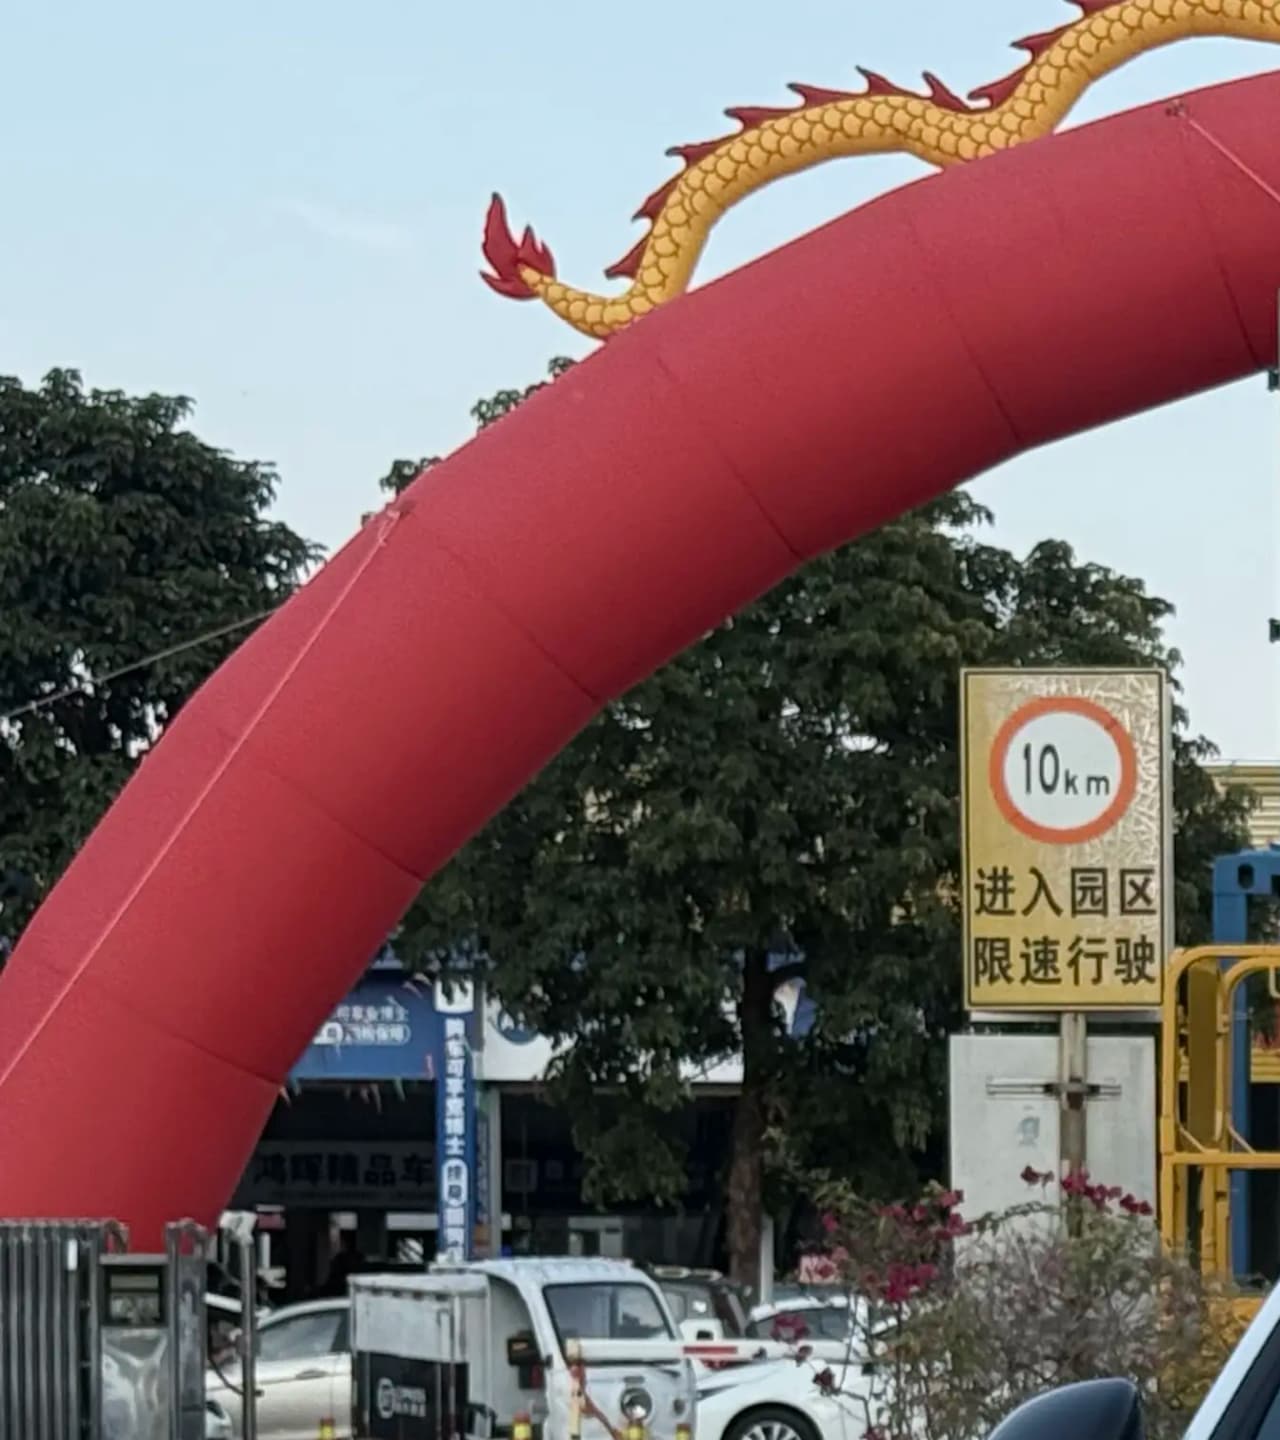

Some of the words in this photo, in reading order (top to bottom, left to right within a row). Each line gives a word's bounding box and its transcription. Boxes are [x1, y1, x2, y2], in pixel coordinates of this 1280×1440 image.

[974, 866, 1157, 917] 进入园区
[974, 935, 1157, 987] 限速行驶
